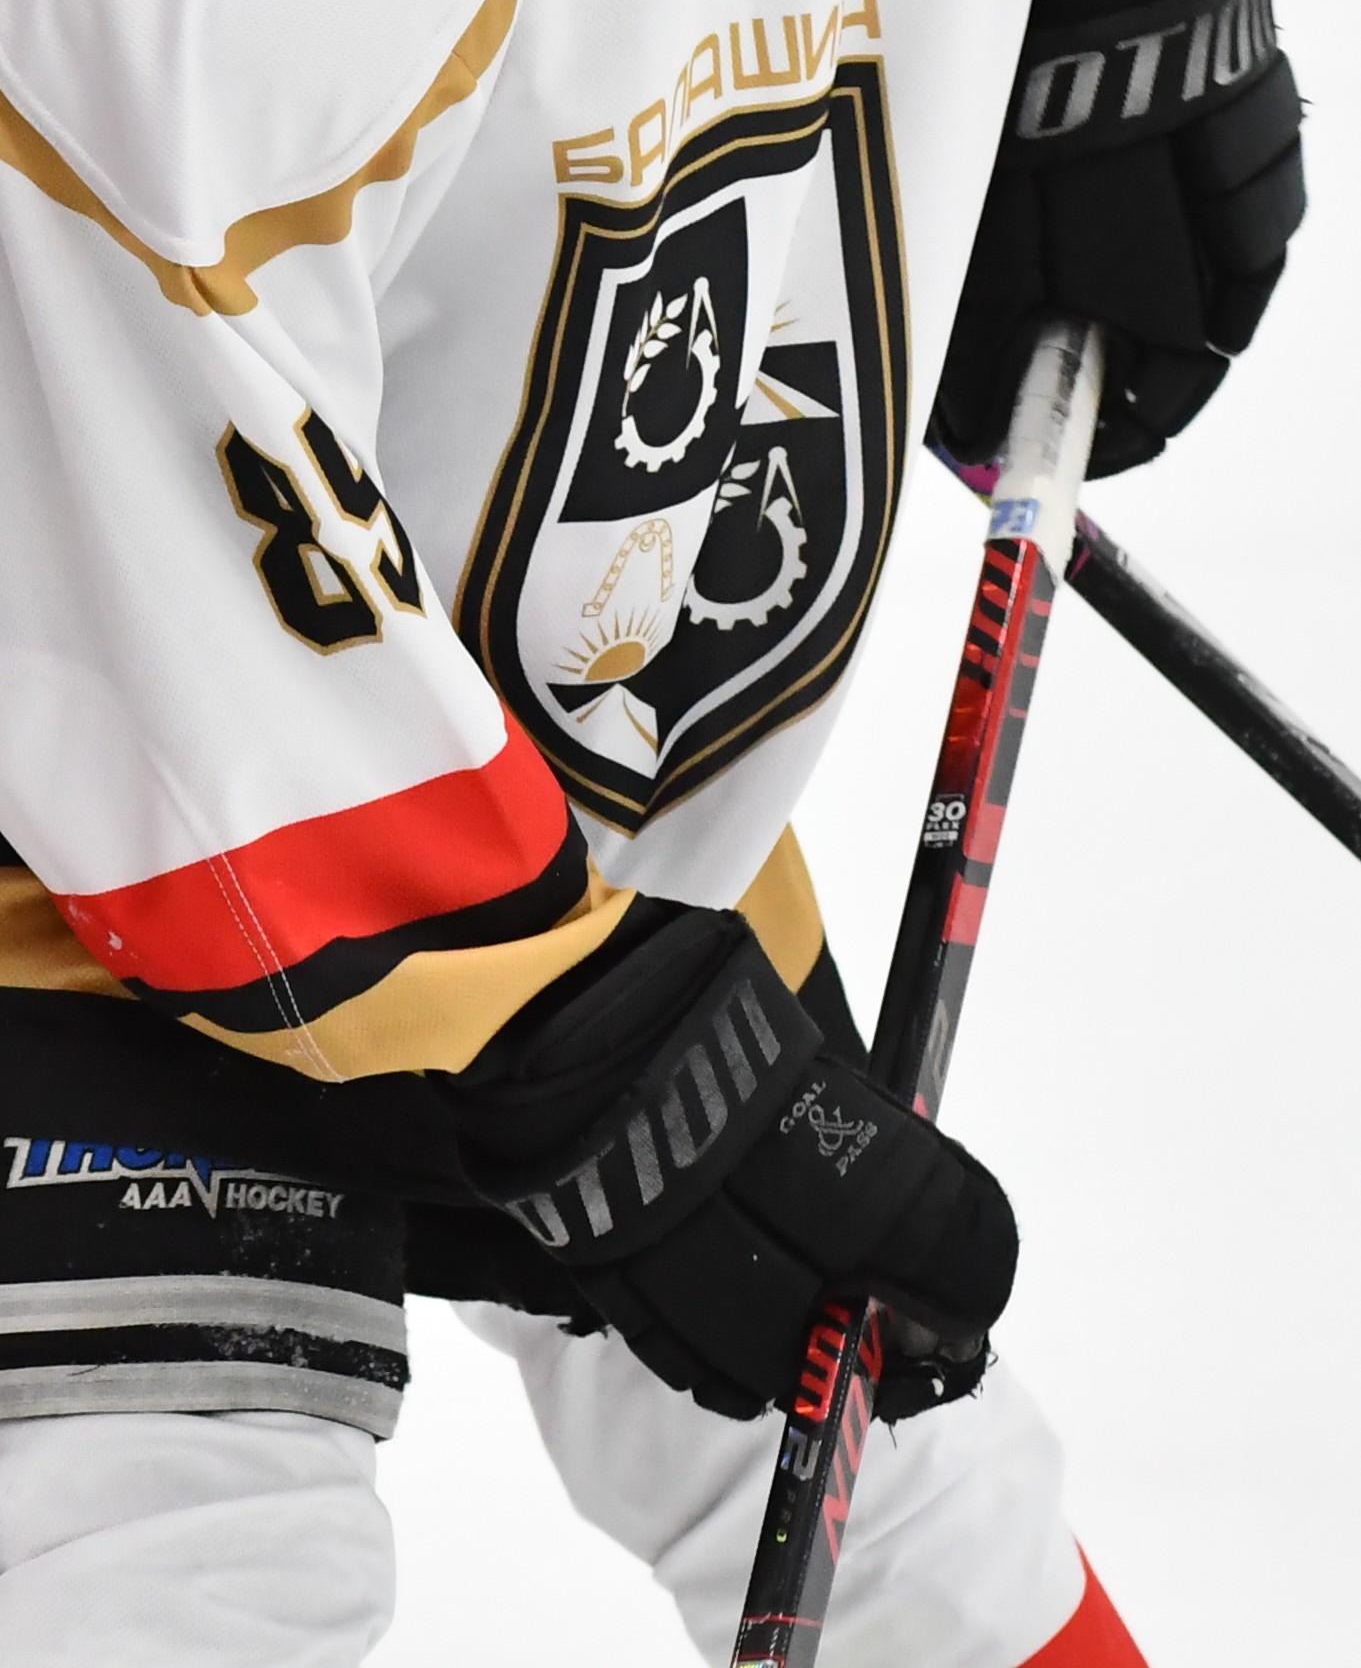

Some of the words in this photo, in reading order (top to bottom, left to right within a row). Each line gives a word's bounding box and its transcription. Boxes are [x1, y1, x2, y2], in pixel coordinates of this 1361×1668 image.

[927, 800, 967, 823] 30
[502, 978, 782, 1248] OTION
[779, 1080, 827, 1134] GOAL
[835, 1120, 878, 1177] PASS
[121, 1182, 192, 1210] AAA
[225, 1182, 344, 1220] HOCKEY
